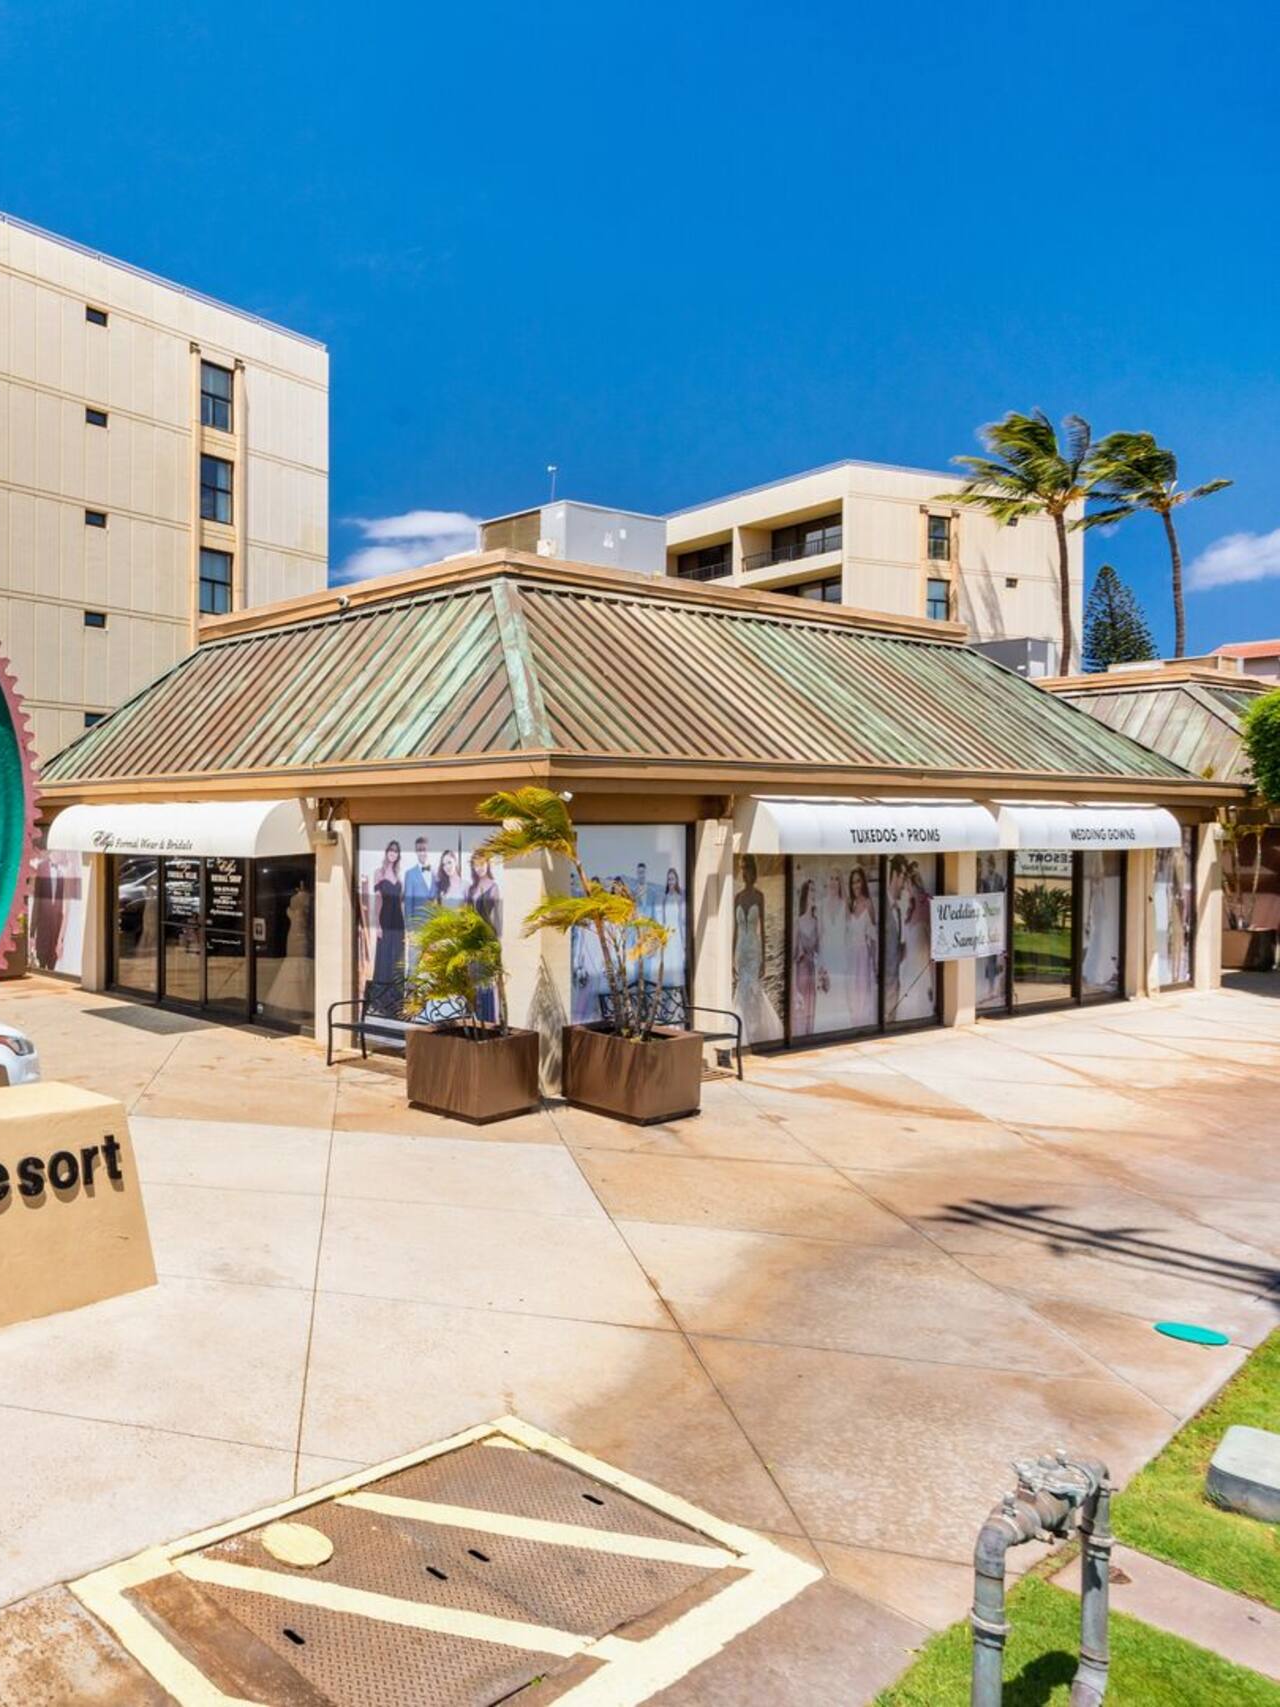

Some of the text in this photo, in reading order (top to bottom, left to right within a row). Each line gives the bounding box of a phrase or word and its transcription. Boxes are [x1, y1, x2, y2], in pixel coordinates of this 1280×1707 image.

[850, 828, 940, 843] TUXEDOS PROMS
[1069, 828, 1136, 841] WEDDING GOWNS
